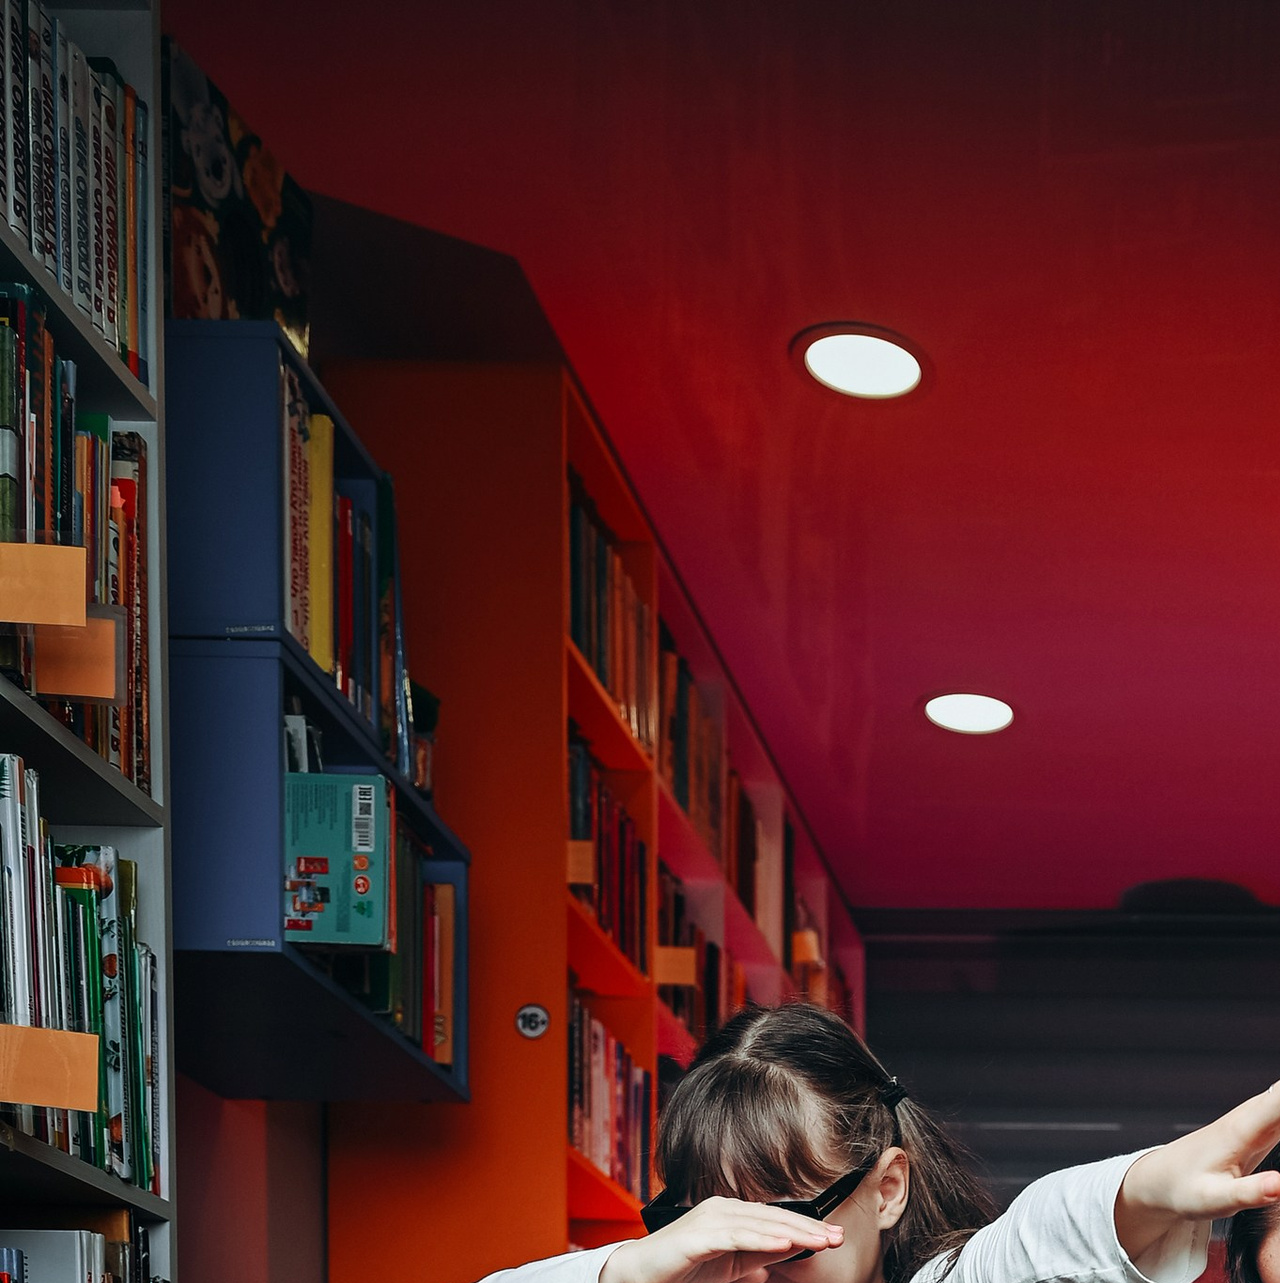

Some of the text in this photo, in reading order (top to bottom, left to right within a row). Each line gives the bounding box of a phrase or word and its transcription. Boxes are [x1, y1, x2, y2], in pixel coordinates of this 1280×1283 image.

[10, 16, 27, 227] Я ПОЗНАЮ МИР
[42, 73, 57, 263] Я ПОЗНАЮ МИР
[75, 116, 87, 175] МИР
[92, 125, 102, 182] МИР
[104, 146, 115, 200] МИР
[76, 176, 89, 278] ПОЗНАЮ
[93, 188, 103, 292] ПОЗНАЮ
[106, 205, 116, 304] ПОЗНАЮ
